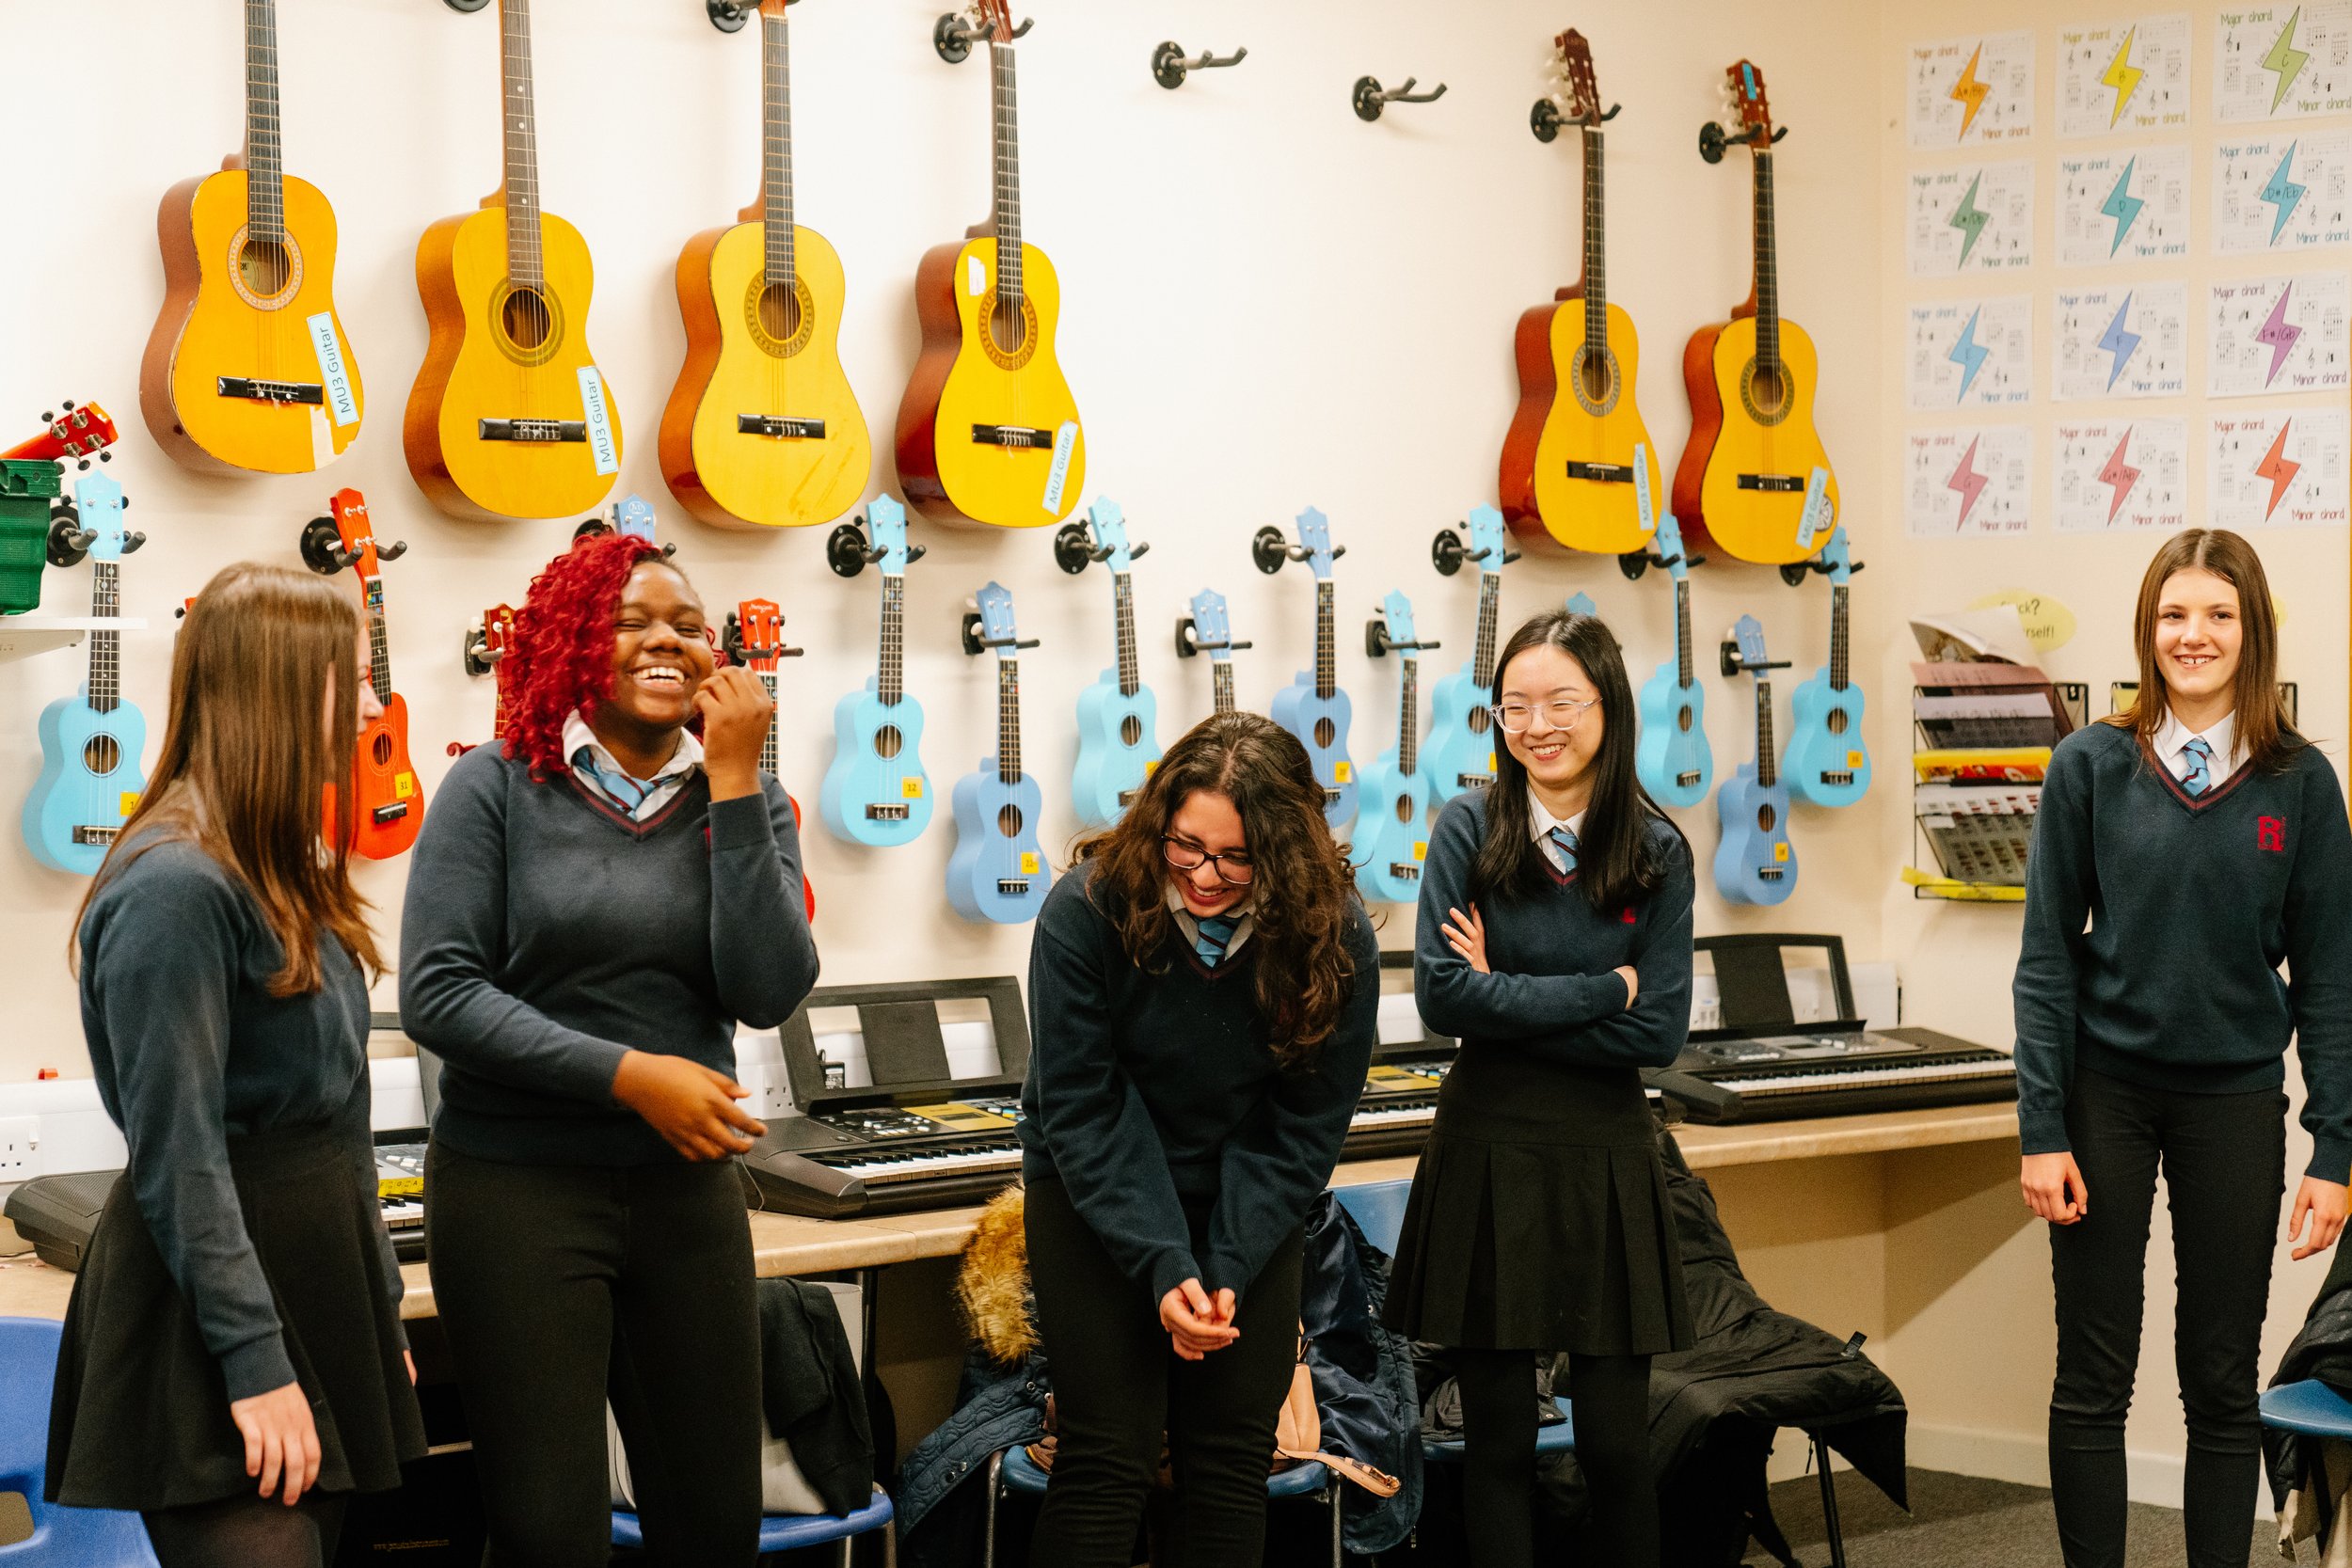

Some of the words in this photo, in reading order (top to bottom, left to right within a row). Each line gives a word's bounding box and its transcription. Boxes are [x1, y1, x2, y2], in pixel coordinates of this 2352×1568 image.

[2221, 14, 2243, 28] Major
[2249, 9, 2272, 23] chord
[2282, 54, 2289, 67] C
[2297, 100, 2321, 112] Minor
[2327, 96, 2351, 109] chord
[2220, 146, 2241, 161] Major
[2247, 143, 2269, 156] chord
[2063, 162, 2082, 175] Major
[2088, 158, 2109, 170] chord
[2120, 200, 2126, 213] D
[2296, 232, 2319, 244] Minor
[2326, 229, 2349, 242] chord
[2136, 245, 2156, 256] Minor
[2163, 241, 2185, 253] chord
[2214, 287, 2235, 302] Major
[2242, 283, 2265, 295] chord
[2059, 295, 2078, 309] Major
[2085, 293, 2106, 304] chord
[2263, 327, 2296, 341] F#/Gb
[320, 327, 340, 373] Guitar
[2132, 380, 2153, 391] Minor
[2158, 378, 2182, 389] chord
[2294, 374, 2316, 386] Minor
[2323, 372, 2346, 384] chord
[332, 376, 351, 413] MU3
[588, 380, 603, 423] Guitar
[2059, 428, 2079, 441] Major
[2086, 425, 2106, 436] chord
[2215, 420, 2235, 436] Major
[2242, 418, 2264, 431] chord
[596, 428, 612, 463] MU3
[1049, 472, 1062, 504] MU3
[1057, 433, 1071, 469] Guitar
[2104, 468, 2135, 482] G#/Ab
[2274, 462, 2281, 476] A
[1964, 475, 1971, 488] G
[2132, 515, 2153, 525] Minor
[2159, 514, 2182, 525] chord
[2292, 509, 2314, 520] Minor
[2321, 508, 2344, 520] chord
[400, 781, 408, 790] 31
[908, 784, 916, 792] 12
